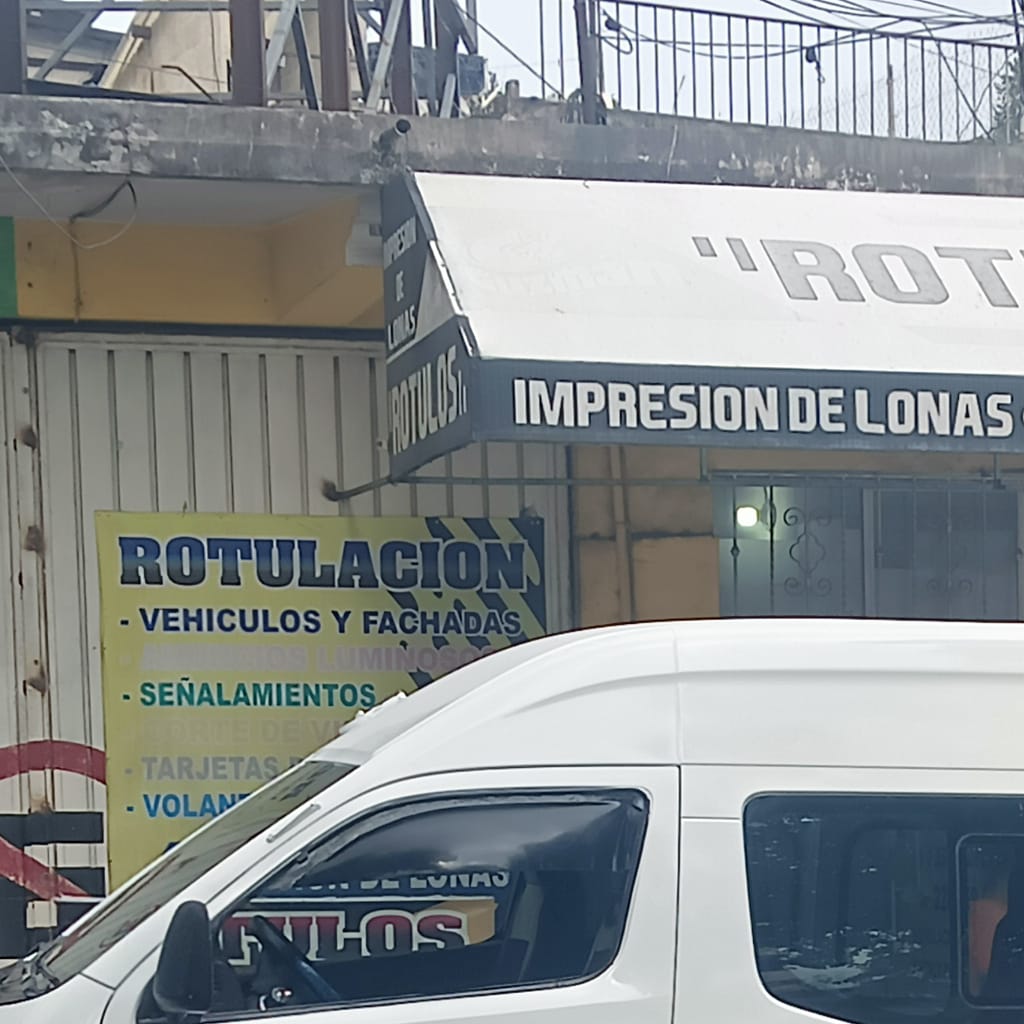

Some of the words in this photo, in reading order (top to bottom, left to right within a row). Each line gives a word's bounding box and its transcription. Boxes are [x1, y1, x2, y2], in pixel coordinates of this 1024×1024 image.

[513, 378, 778, 431] IMPRESION
[787, 387, 846, 433] DE
[854, 388, 1013, 438] LONAS
[117, 536, 528, 592] ROTULACION
[138, 608, 321, 634] VEHICULOS
[331, 610, 352, 634] Y
[362, 611, 522, 636] FACHADAS
[317, 645, 498, 674] LUMINOSO
[139, 677, 377, 708] SEÑALAMIENTOS
[141, 756, 280, 780] TARJETAS
[143, 793, 252, 818] VOLAN
